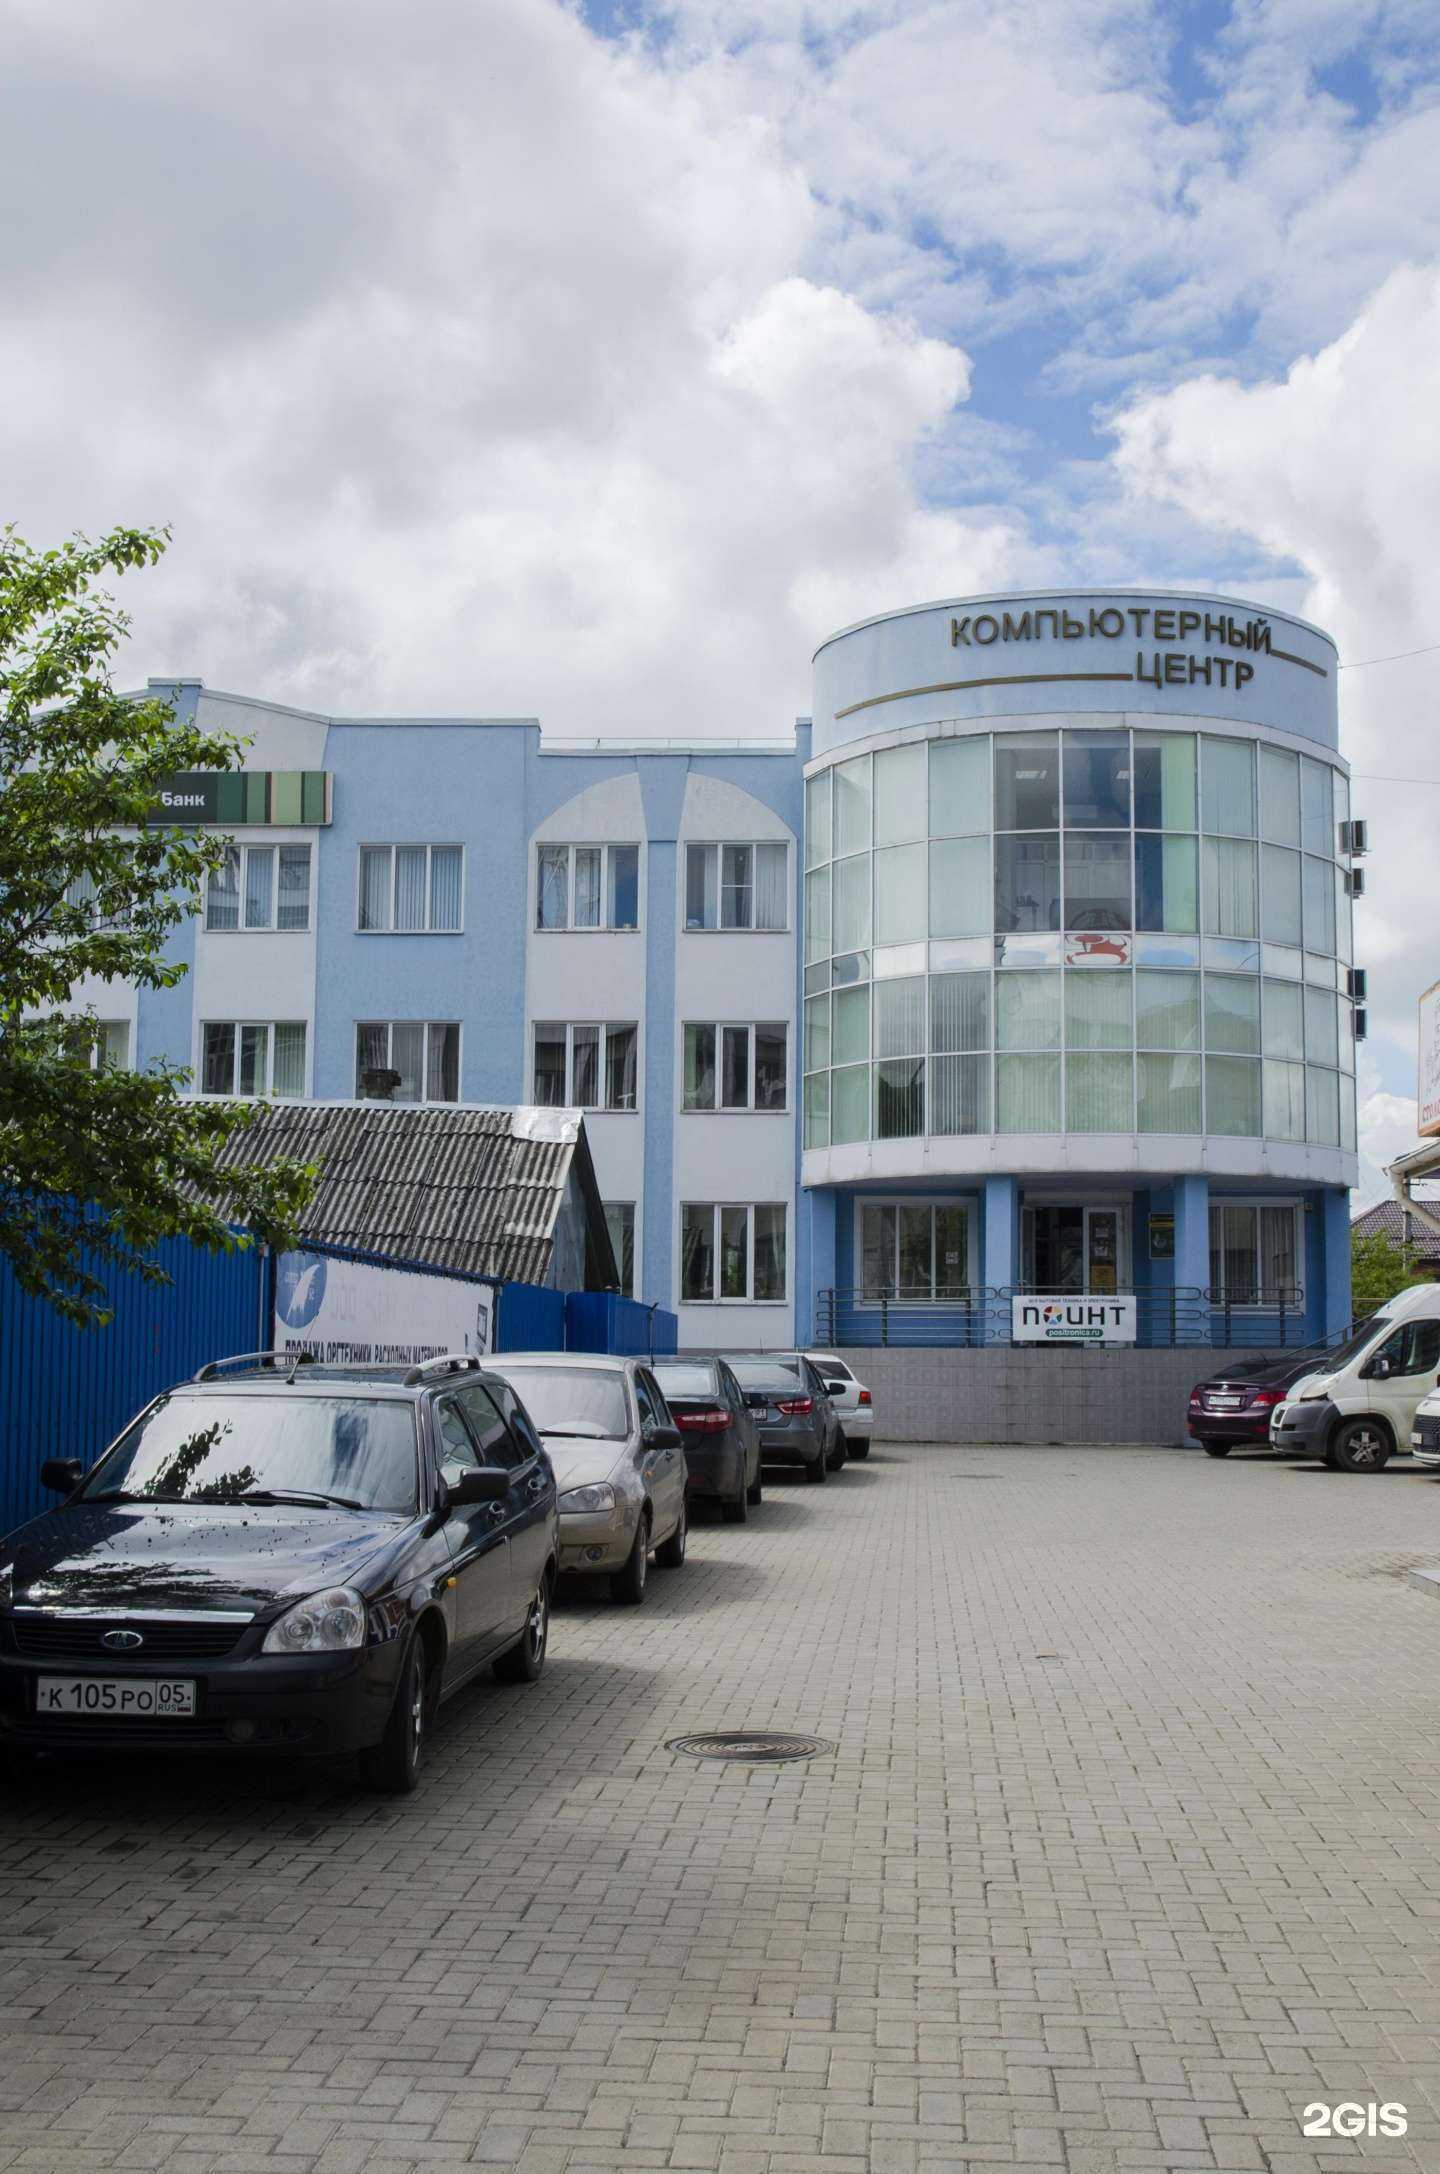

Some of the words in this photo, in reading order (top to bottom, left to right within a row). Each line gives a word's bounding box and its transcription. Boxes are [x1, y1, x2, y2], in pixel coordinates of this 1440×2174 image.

[951, 608, 1272, 654] КОМПЬЮТЕРНЫЙ
[1136, 651, 1255, 690] ЦЕНТР
[161, 791, 206, 807] Банк
[1048, 1328, 1100, 1337] positronica.ru
[374, 1344, 412, 1364] РАСХОДНЫХ
[159, 1684, 185, 1704] 05
[158, 1704, 177, 1713] RUS
